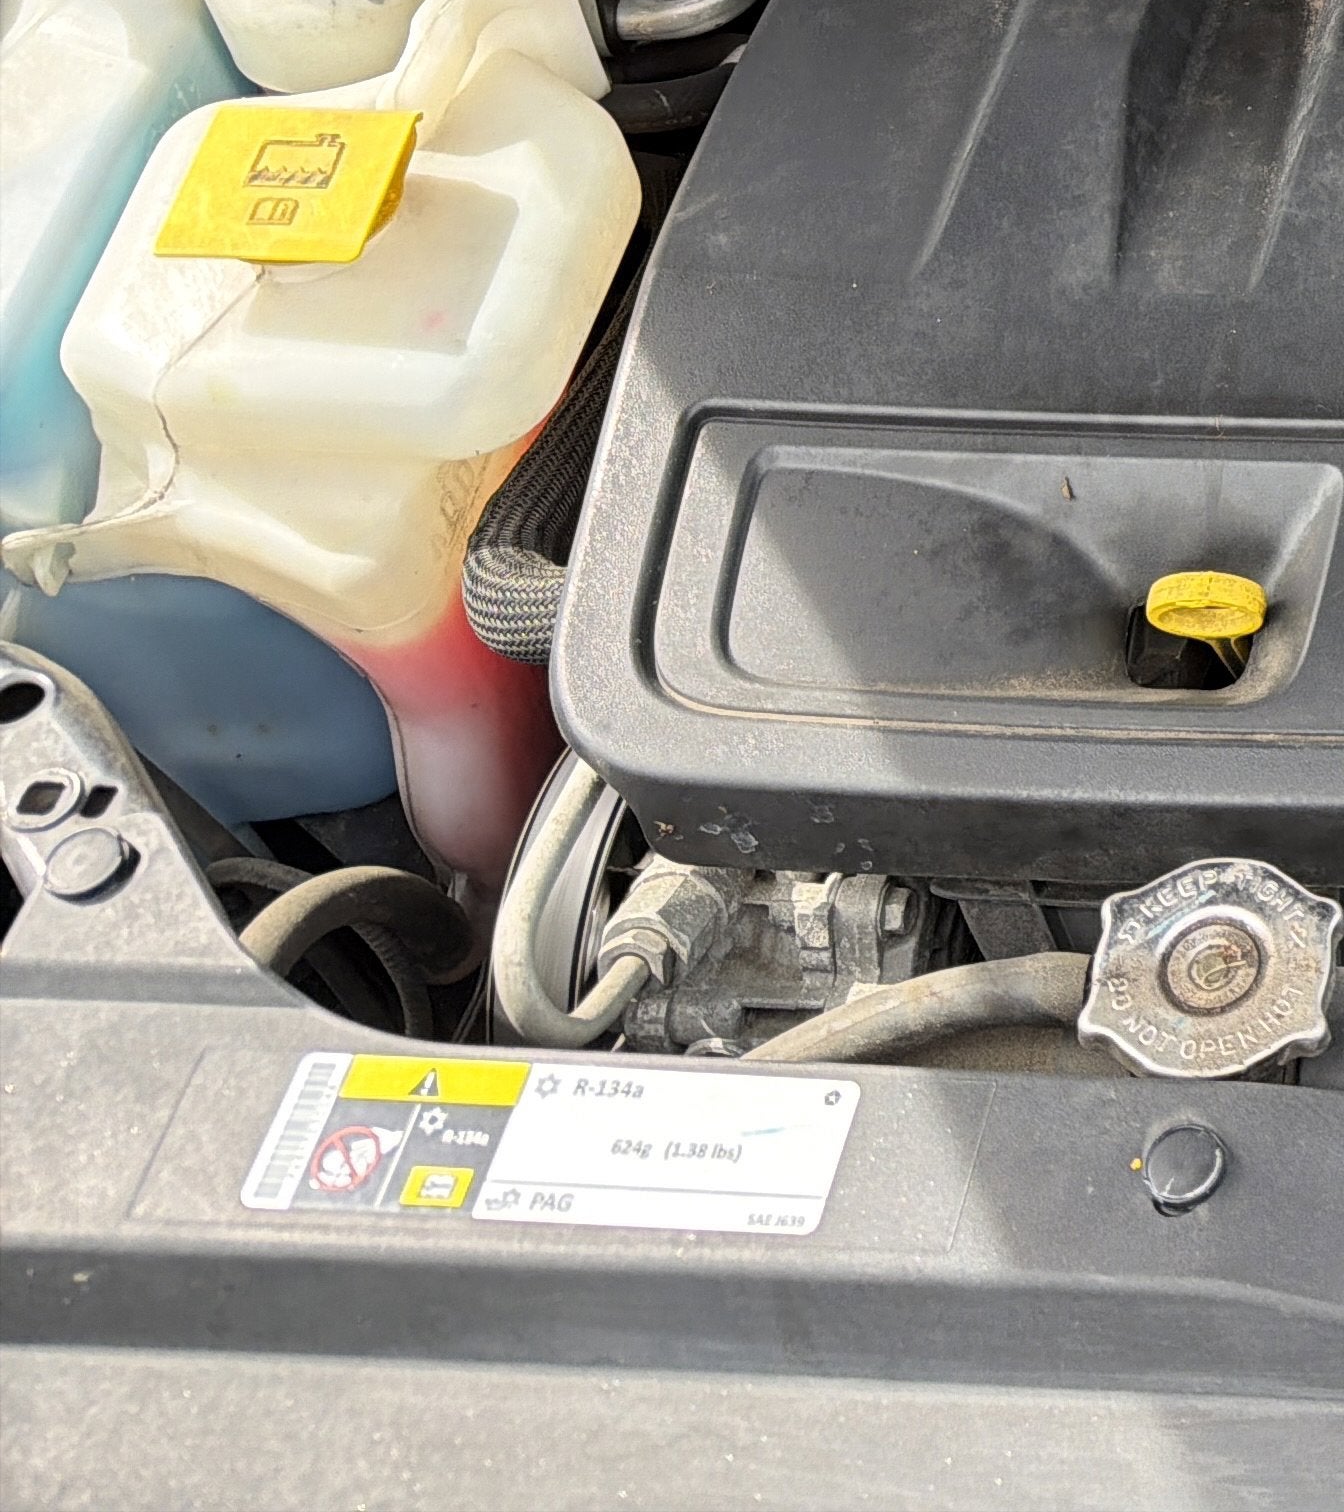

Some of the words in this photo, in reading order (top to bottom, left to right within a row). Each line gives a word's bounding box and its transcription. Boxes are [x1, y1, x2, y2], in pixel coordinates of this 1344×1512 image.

[1138, 869, 1218, 918] KEEP
[1232, 871, 1305, 921] TIGHT
[1122, 1015, 1177, 1052] NOT
[1179, 1028, 1257, 1060] OPEN
[1257, 987, 1305, 1033] HOT
[572, 1079, 645, 1101] R-134a
[611, 1138, 652, 1160] 624g
[664, 1141, 708, 1161] (1.38
[711, 1143, 743, 1164] lbs)
[529, 1192, 574, 1214] PAG
[747, 1213, 773, 1227] SAE
[774, 1214, 806, 1228] J639
